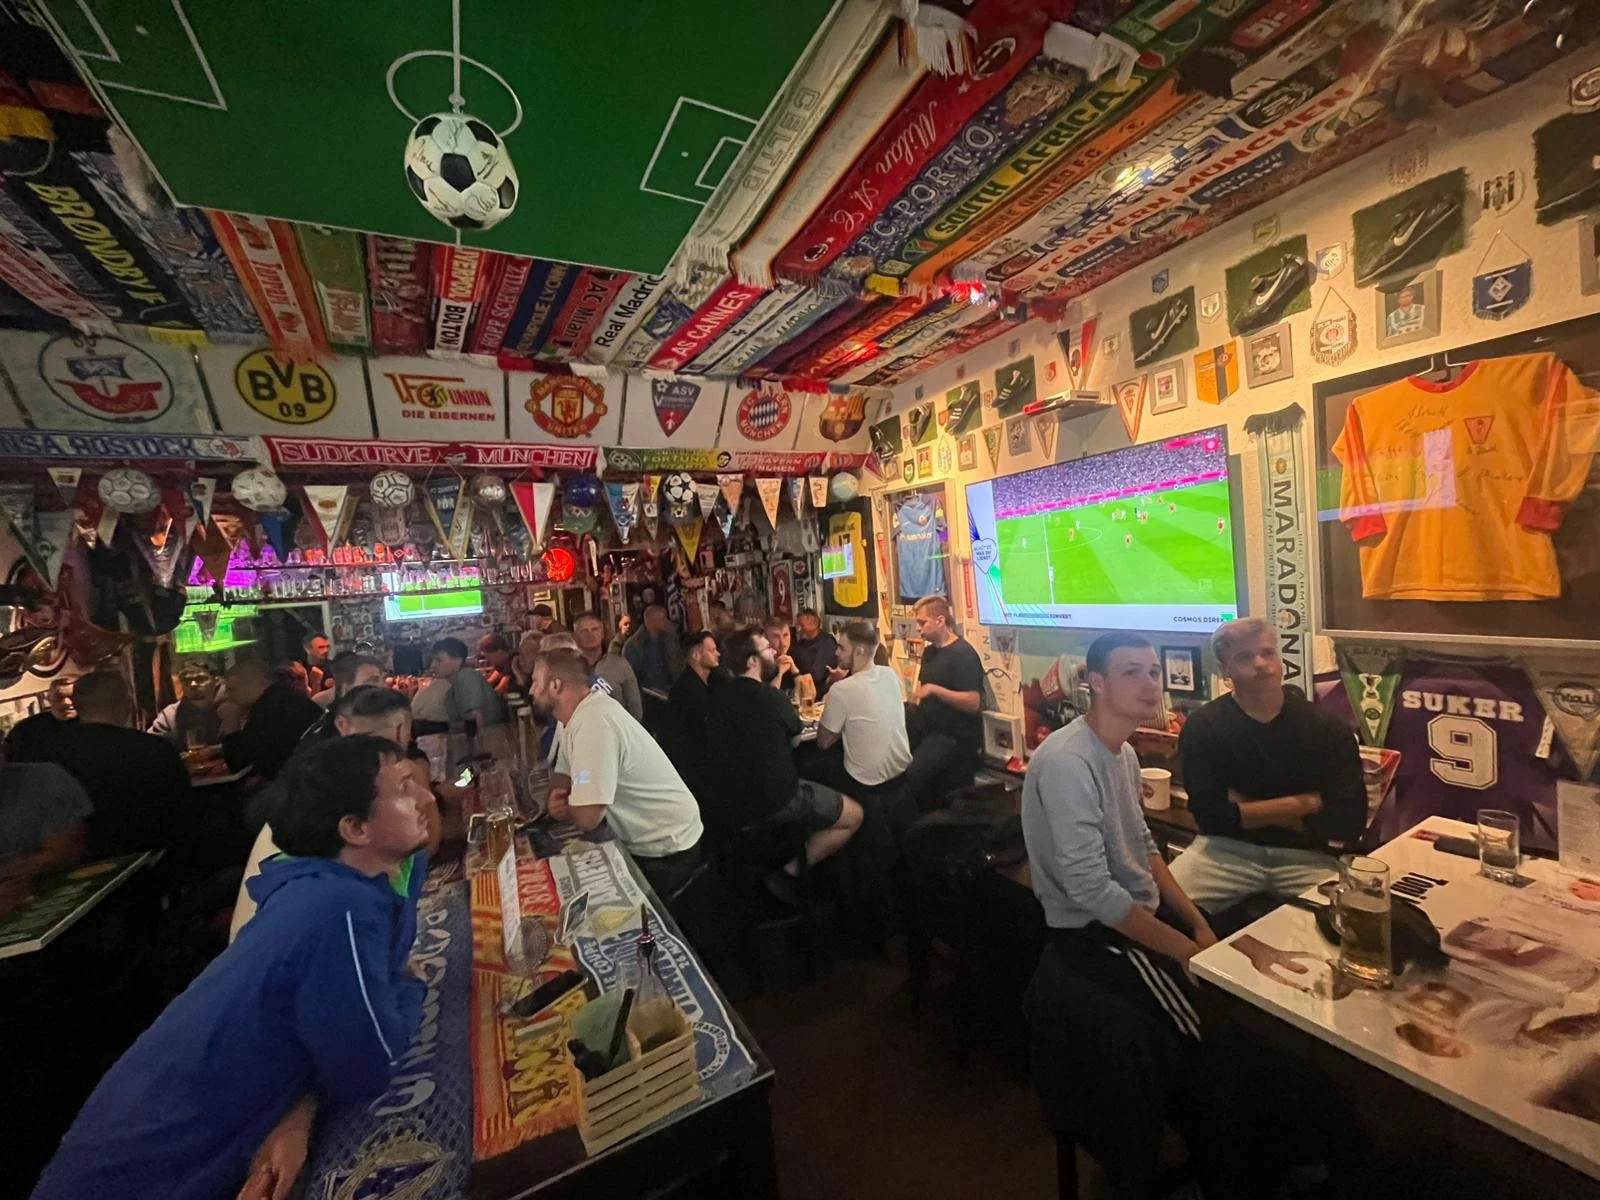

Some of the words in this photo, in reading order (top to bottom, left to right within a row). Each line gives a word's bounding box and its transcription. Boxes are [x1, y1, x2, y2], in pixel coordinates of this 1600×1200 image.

[741, 87, 821, 191] CELTIC
[875, 100, 938, 175] Milan
[933, 179, 1010, 235] SOUTH
[1008, 87, 1130, 175] AFRICA
[857, 219, 899, 255] FC
[896, 124, 996, 220] PORTO
[1038, 254, 1062, 272] FC
[1067, 196, 1167, 255] BAYERN
[590, 281, 607, 303] AC
[440, 304, 467, 347] BOLTON
[564, 301, 598, 339] Milan
[595, 313, 621, 349] Real
[675, 336, 697, 360] AS
[686, 289, 753, 341] CANNES
[247, 355, 326, 403] BVB
[448, 389, 491, 406] UNION
[672, 385, 696, 396] ASV
[279, 401, 307, 417] 09
[402, 410, 425, 419] DIE
[430, 411, 495, 421] EISERNEN
[1273, 479, 1302, 681] MARADONA
[1402, 689, 1524, 722] SUKER
[1427, 714, 1498, 791] 9
[583, 941, 617, 976] COUPE
